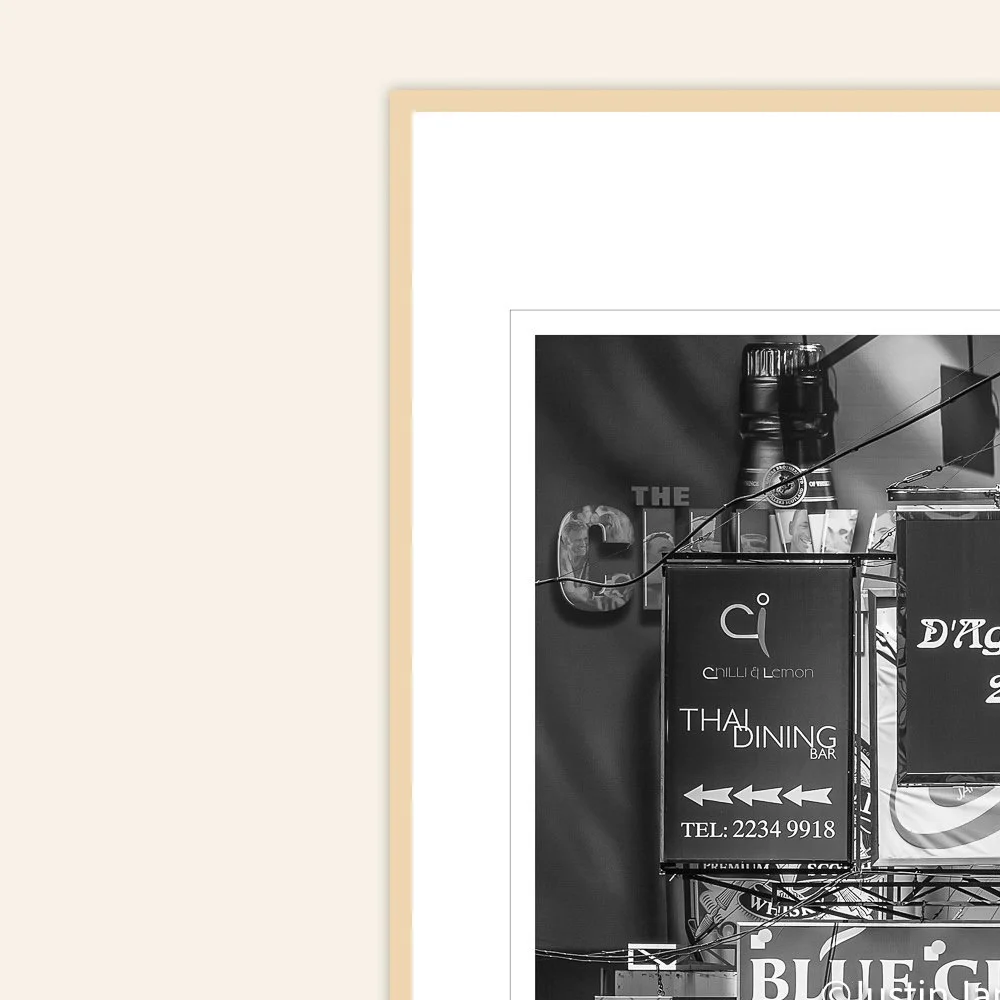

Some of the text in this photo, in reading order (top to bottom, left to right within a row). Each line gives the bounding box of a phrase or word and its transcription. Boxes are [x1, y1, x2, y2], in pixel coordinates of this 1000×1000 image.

[631, 486, 690, 507] THE
[763, 667, 814, 679] Lemon
[679, 708, 749, 732] THAI
[733, 725, 837, 749] DINING
[810, 748, 837, 760] BAR
[681, 820, 836, 839] TEL: 2234 9918
